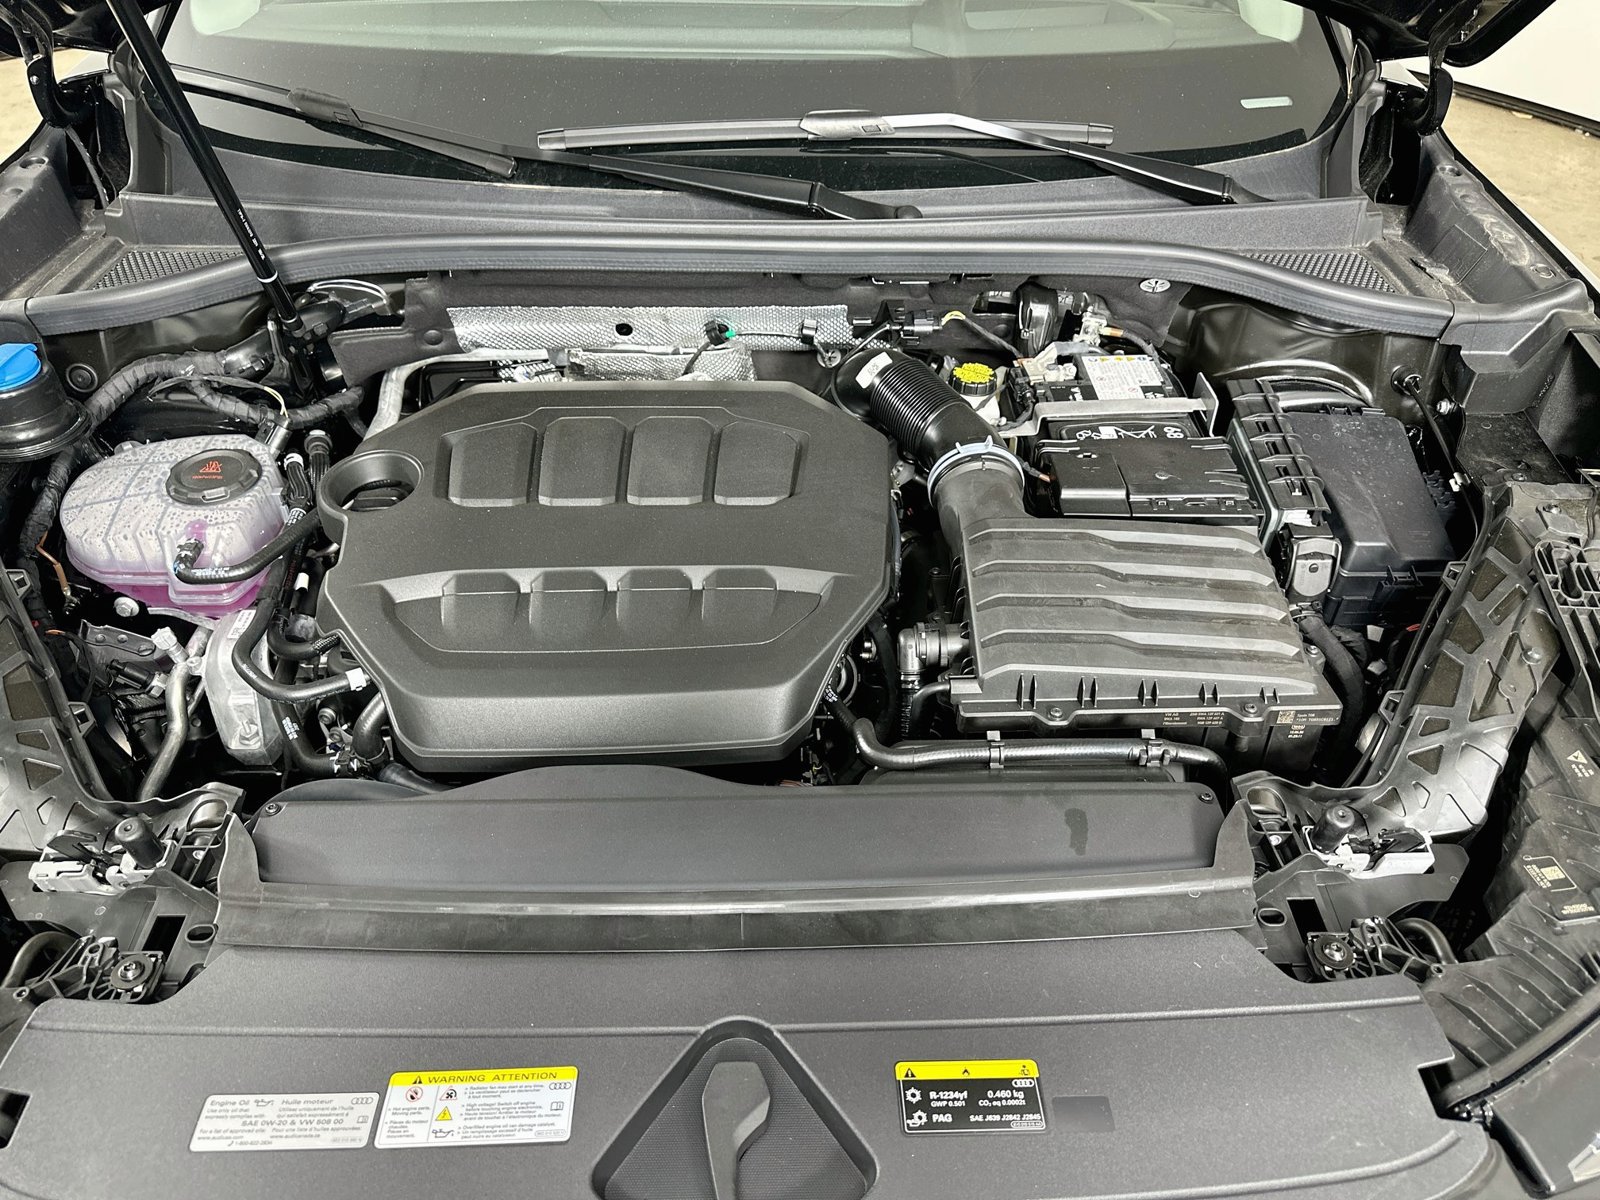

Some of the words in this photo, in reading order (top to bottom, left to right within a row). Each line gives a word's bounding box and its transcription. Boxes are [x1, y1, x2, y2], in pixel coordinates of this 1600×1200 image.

[428, 1075, 486, 1084] WARNING
[491, 1072, 558, 1082] ATTENTION
[929, 1090, 968, 1101] R-1234yf
[1013, 1089, 1025, 1099] kg
[930, 1100, 948, 1108] GWP
[932, 1113, 953, 1123] PAG
[969, 1114, 984, 1122] SAE
